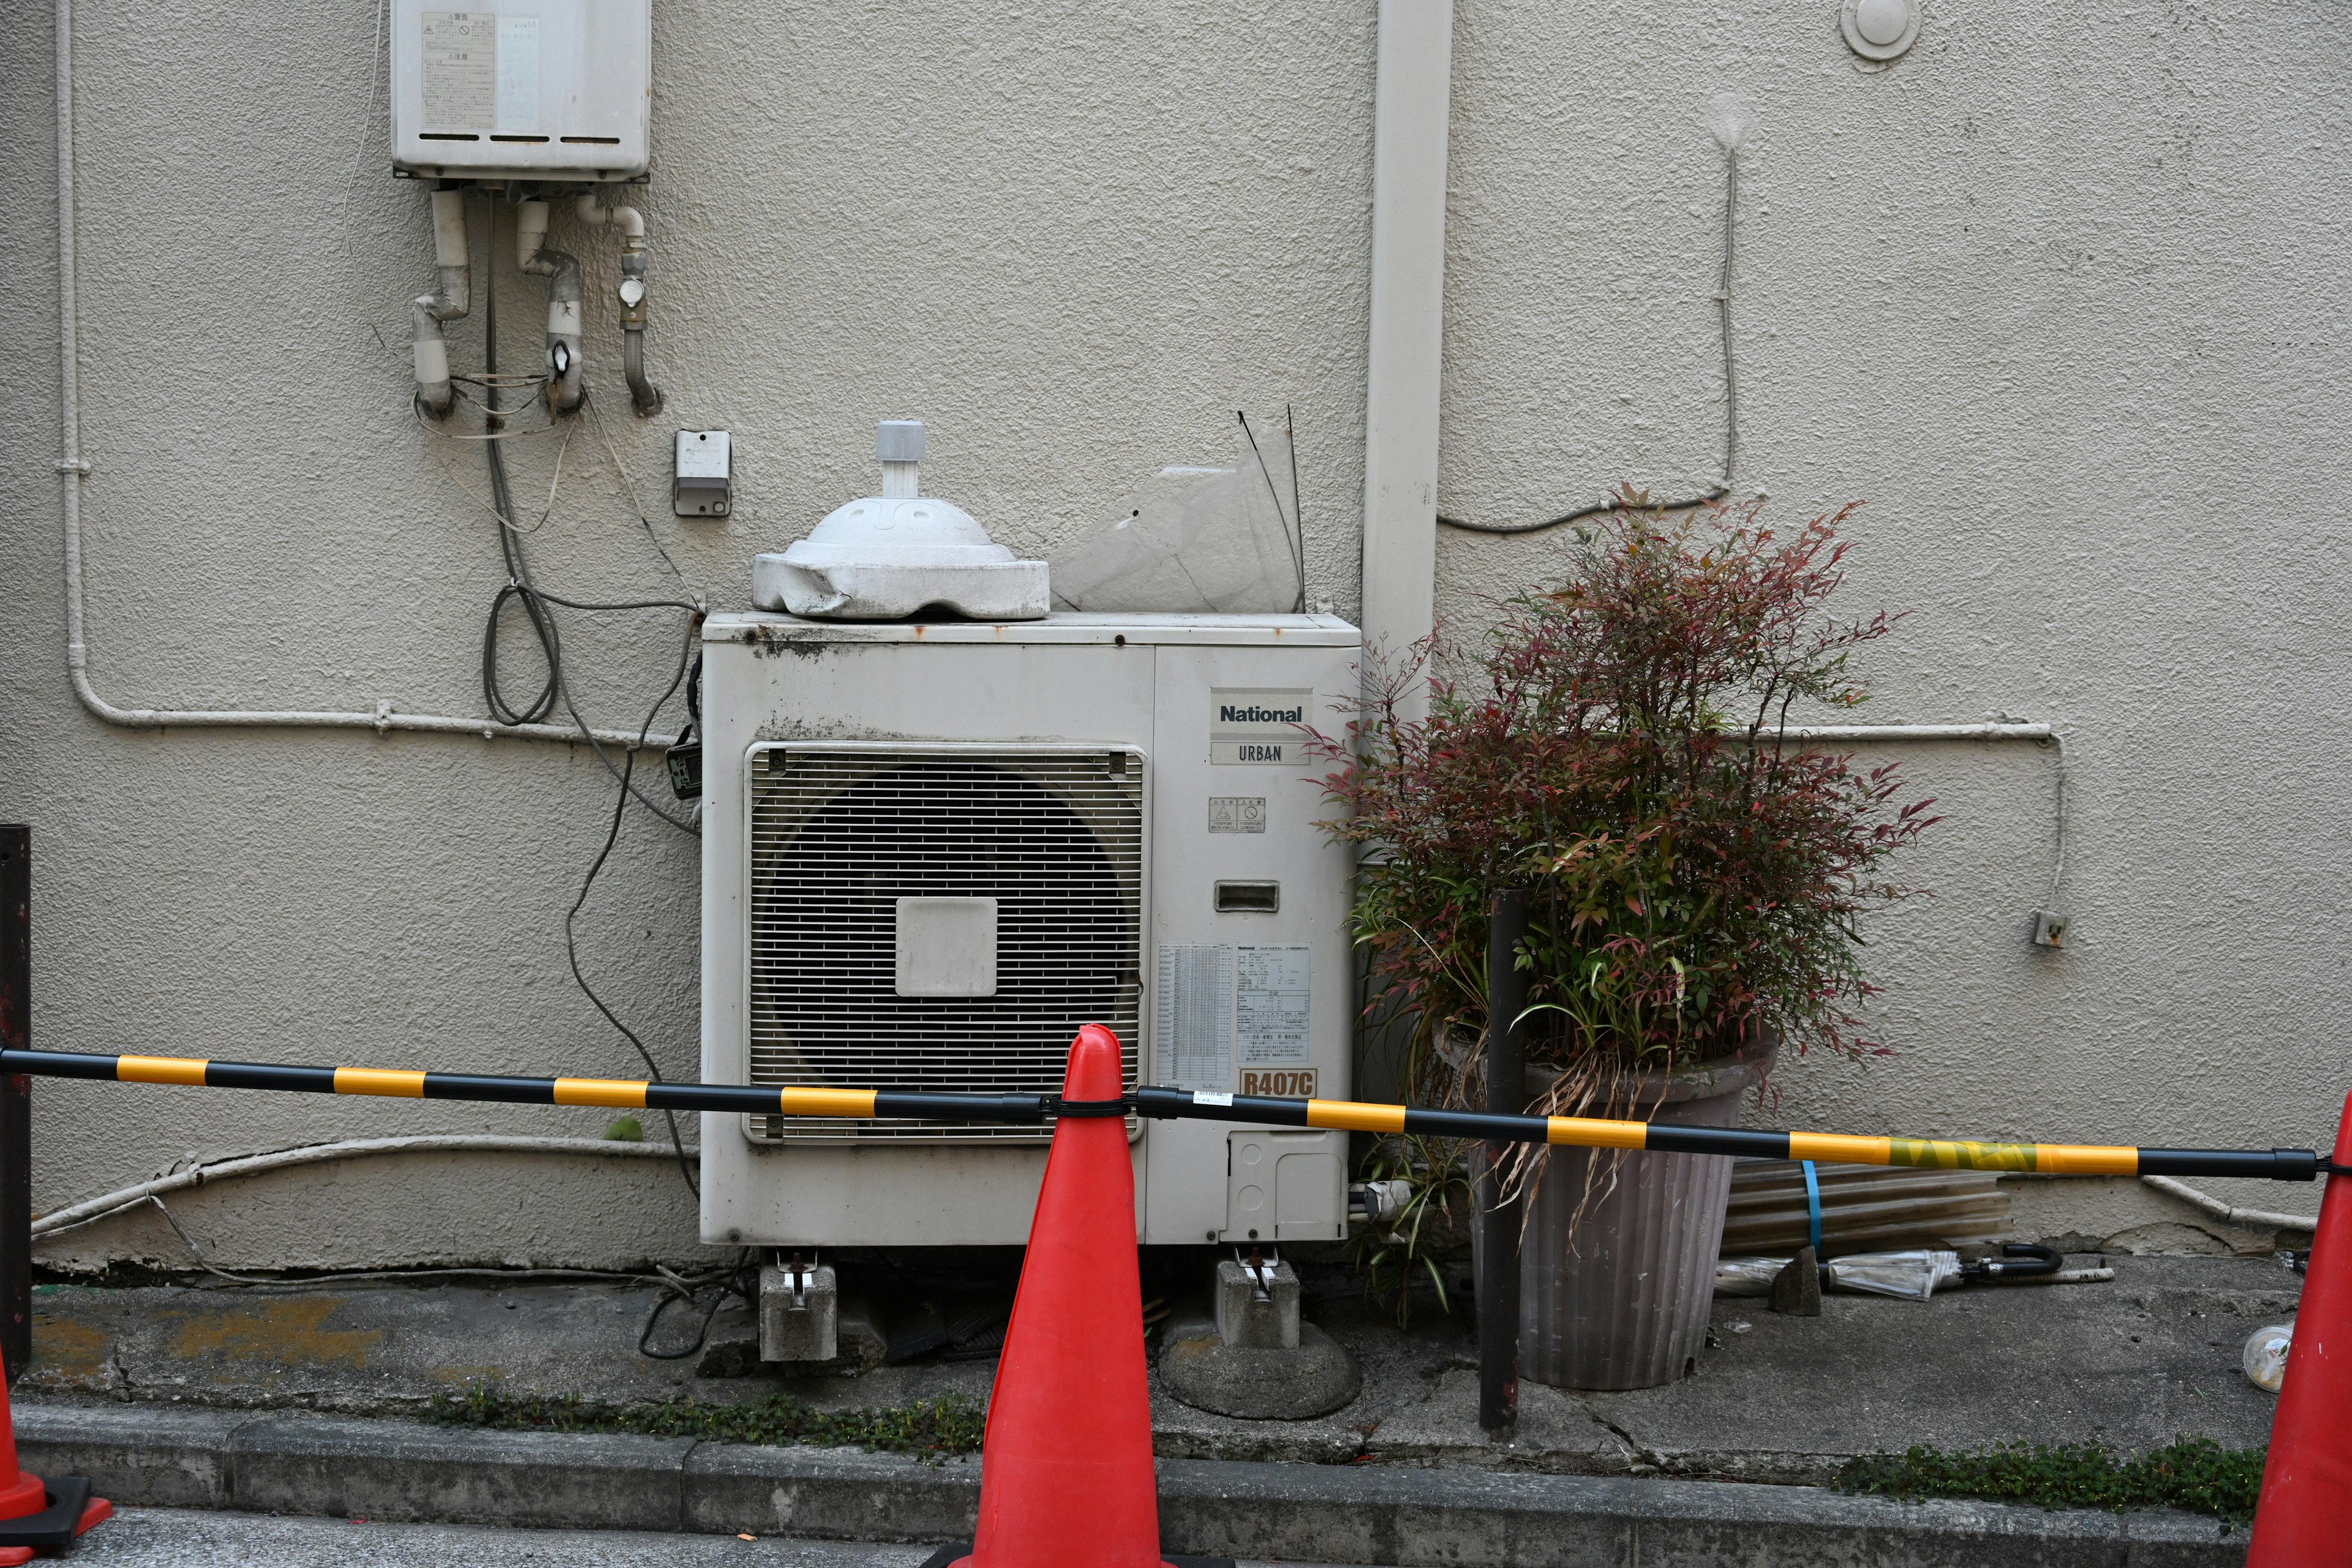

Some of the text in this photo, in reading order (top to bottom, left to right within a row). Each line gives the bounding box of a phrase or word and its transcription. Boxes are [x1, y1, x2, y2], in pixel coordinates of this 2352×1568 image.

[1220, 705, 1302, 723] National
[1239, 745, 1281, 762] URBAN
[1244, 1072, 1313, 1095] R407C
